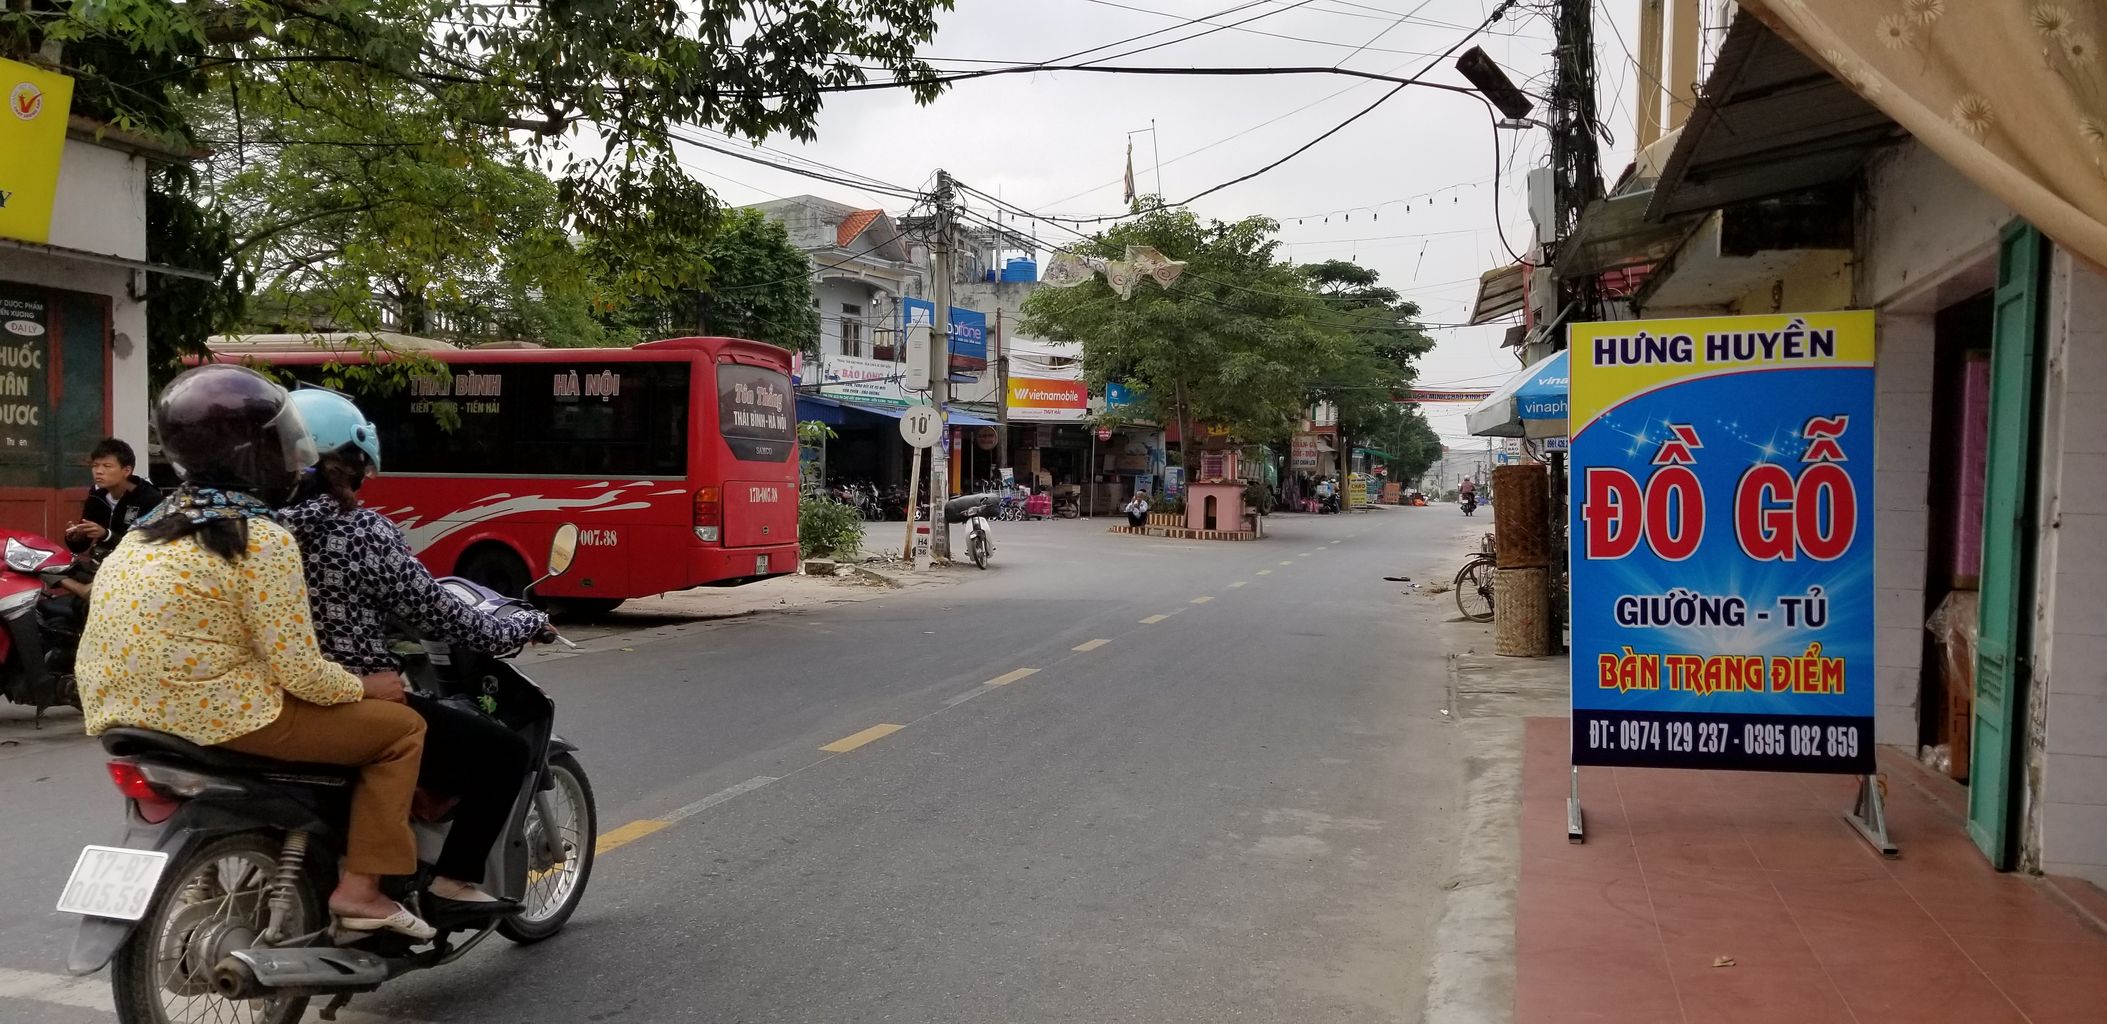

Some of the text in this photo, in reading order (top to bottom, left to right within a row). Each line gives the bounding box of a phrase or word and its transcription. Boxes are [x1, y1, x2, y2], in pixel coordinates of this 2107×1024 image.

[1593, 318, 1834, 365] HƯNG HUYỀN
[455, 370, 502, 396] BÌNH
[553, 369, 580, 396] HÀ
[585, 369, 620, 402] NỘI
[1029, 388, 1079, 401] vietnamobile
[1582, 415, 1858, 562] ĐỒ GỖ
[580, 529, 618, 546] 007.38
[917, 537, 928, 546] H4
[1615, 589, 1746, 627] GIƯỜNG
[1780, 587, 1826, 627] TỦ
[1598, 642, 1846, 696] BÀN TRANG ĐIỂM
[1589, 720, 1615, 749] ĐT:
[1620, 720, 1661, 751] 0974
[1666, 721, 1693, 752] 129
[1698, 723, 1729, 753] 237
[1744, 723, 1785, 755] 0395
[1790, 725, 1821, 756] 082
[1827, 726, 1859, 757] 859
